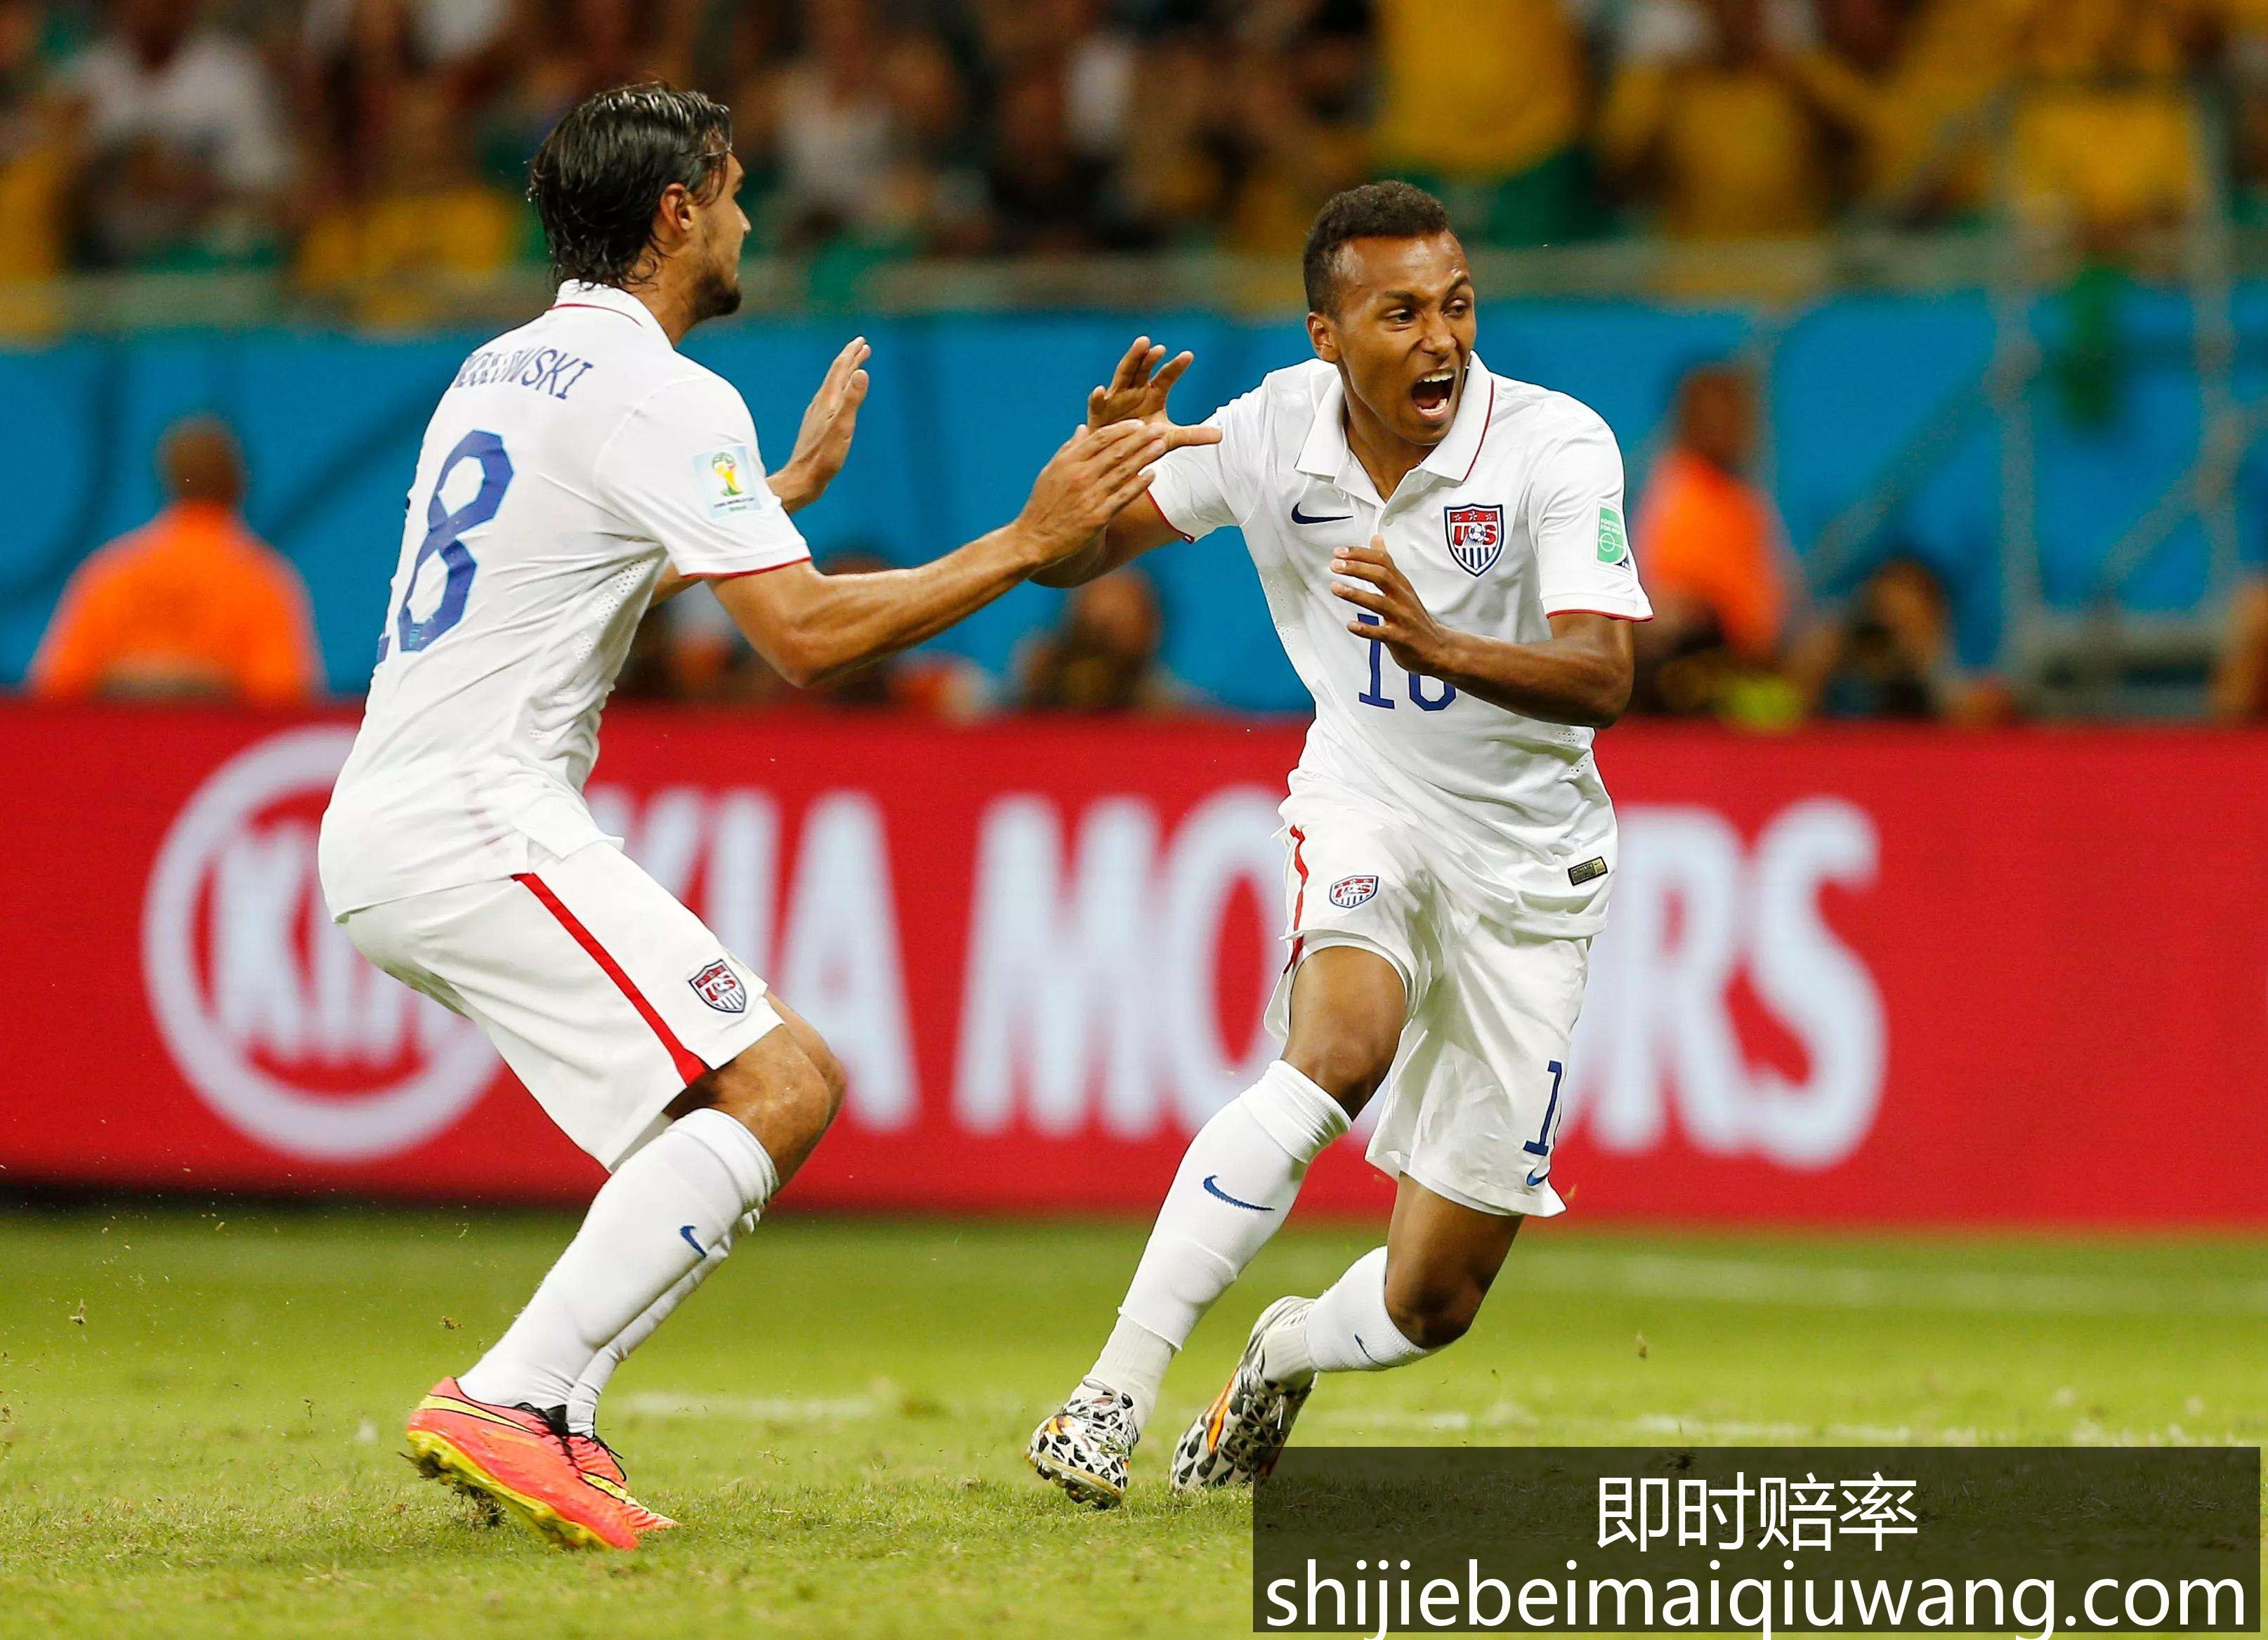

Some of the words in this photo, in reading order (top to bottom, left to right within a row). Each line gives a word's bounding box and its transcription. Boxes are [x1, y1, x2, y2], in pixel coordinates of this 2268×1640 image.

[376, 429, 514, 662] 8
[1454, 525, 1497, 546] US
[952, 788, 1891, 1169] MORS
